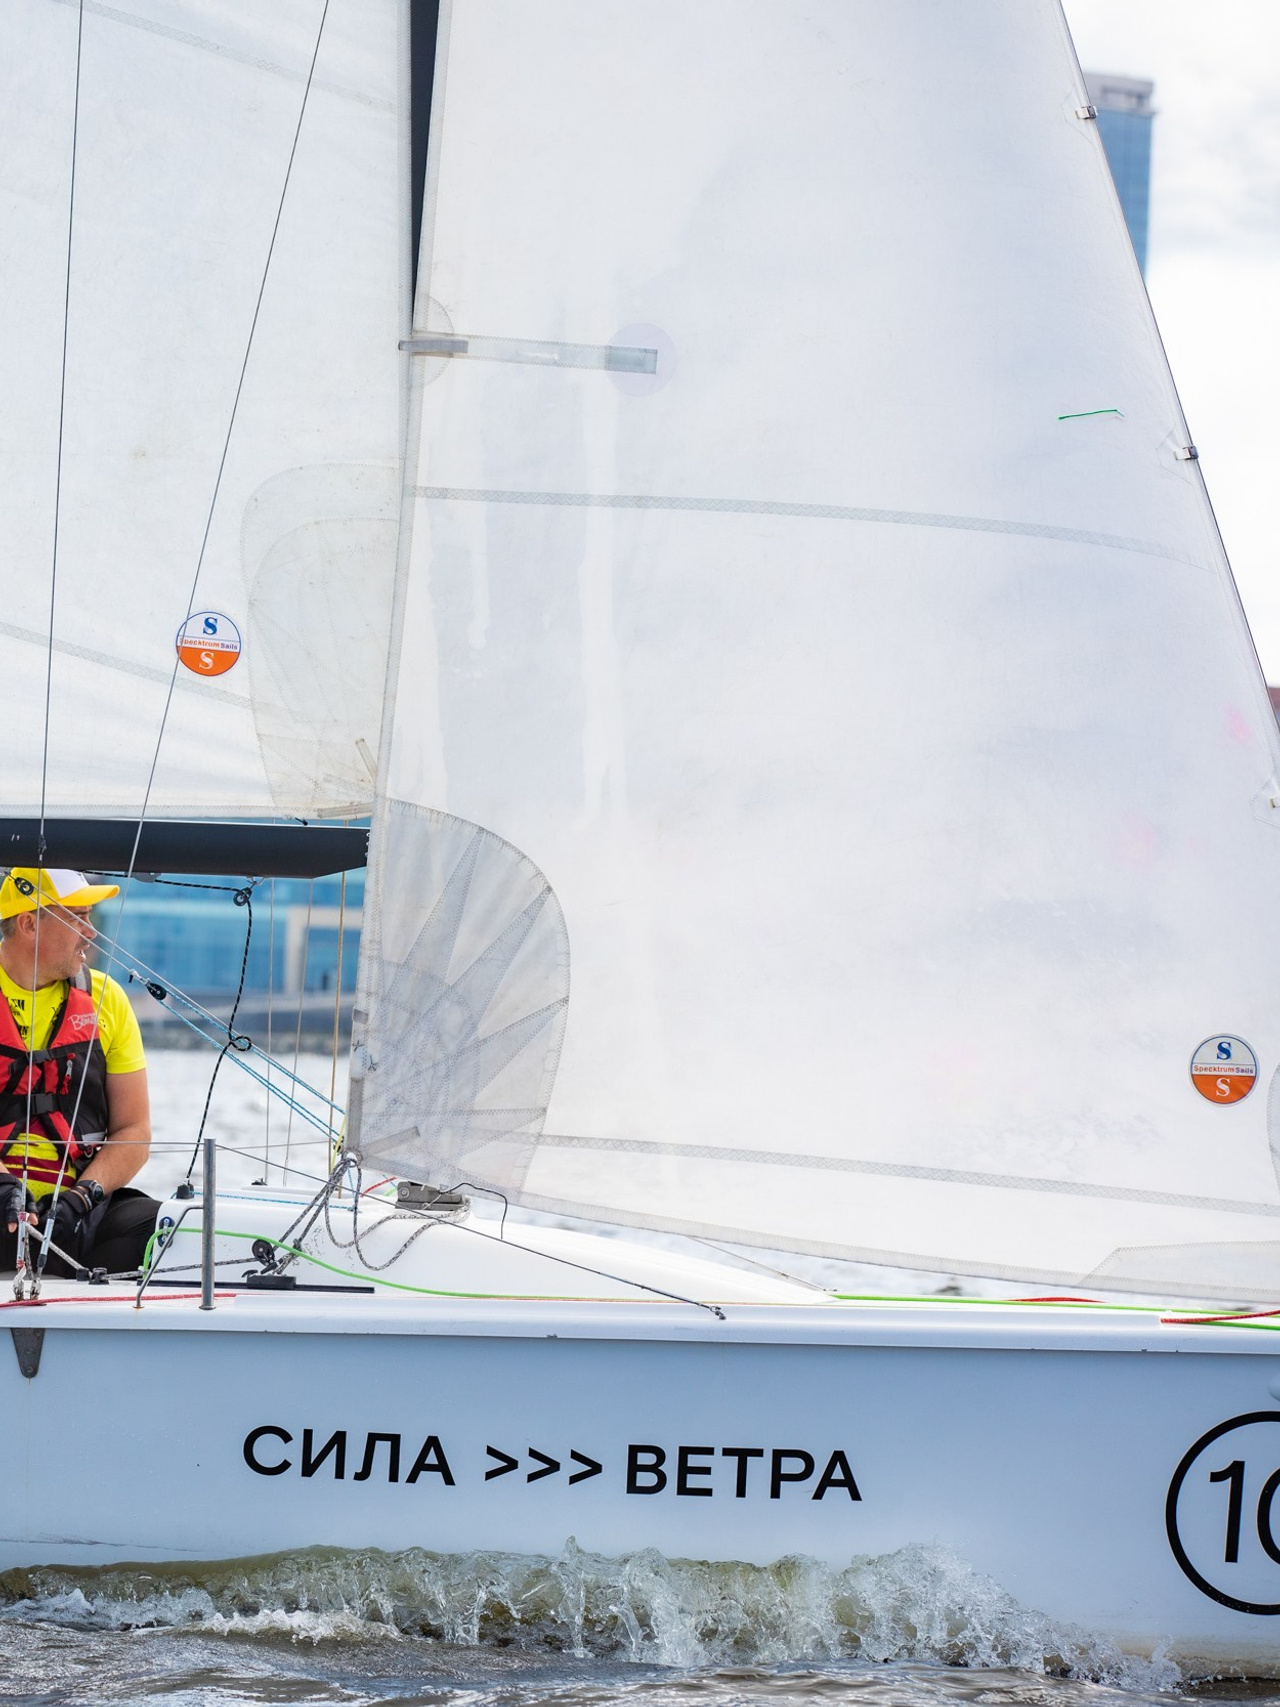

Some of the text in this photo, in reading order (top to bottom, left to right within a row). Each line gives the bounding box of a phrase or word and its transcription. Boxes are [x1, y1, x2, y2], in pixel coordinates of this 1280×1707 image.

[203, 617, 218, 636] S
[220, 642, 238, 650] Sails
[199, 651, 215, 670] S
[1216, 1041, 1232, 1061] S
[1235, 1066, 1254, 1074] Sails
[1215, 1077, 1231, 1097] S
[242, 1425, 456, 1486] СИЛА
[626, 1444, 863, 1502] ВЕТРА
